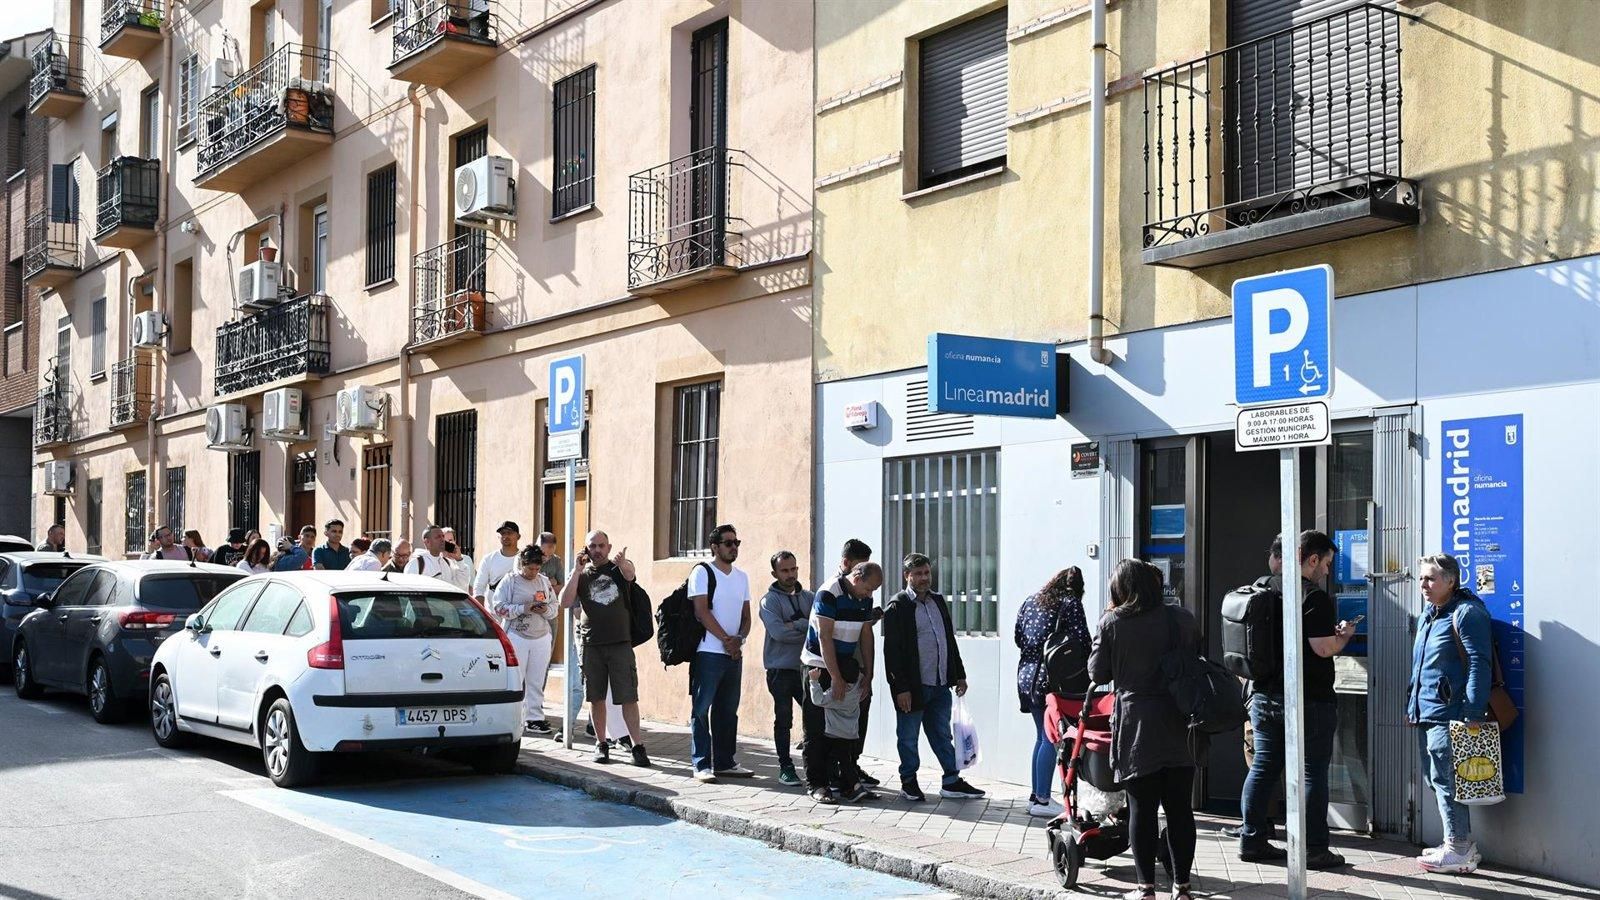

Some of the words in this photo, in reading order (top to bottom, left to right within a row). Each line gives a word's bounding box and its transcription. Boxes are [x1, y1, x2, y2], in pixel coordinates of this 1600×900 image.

[1251, 287, 1310, 388] P
[944, 350, 965, 360] oficina
[965, 354, 1001, 364] numancia
[1283, 364, 1290, 382] 1
[554, 366, 576, 425] P
[1251, 407, 1299, 419] LABORABLES
[1300, 406, 1310, 414] DE
[1288, 415, 1314, 423] HORAS
[1245, 427, 1276, 436] GESTIÓN
[1277, 423, 1317, 433] MUNICIPAL
[1252, 434, 1281, 443] MÁXIMO
[1288, 432, 1310, 440] HORA
[1473, 474, 1493, 482] oficina
[1474, 480, 1508, 489] numancia
[1446, 428, 1470, 590] eamadrid
[408, 709, 438, 722] 4457
[443, 709, 467, 722] DPS
